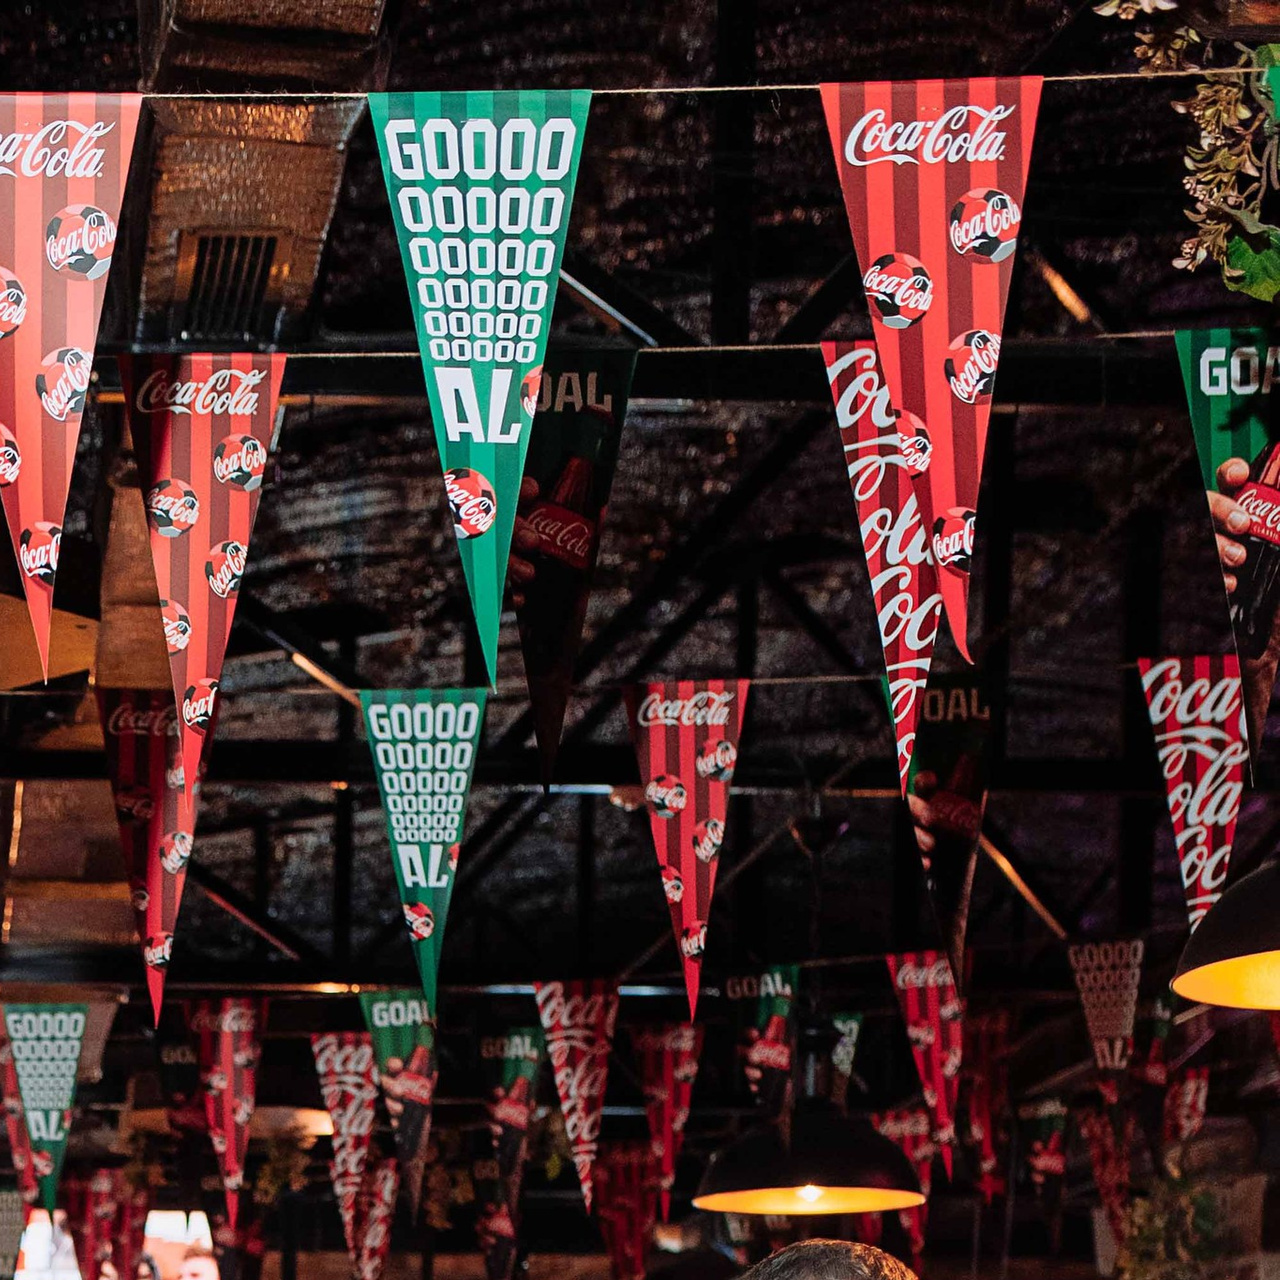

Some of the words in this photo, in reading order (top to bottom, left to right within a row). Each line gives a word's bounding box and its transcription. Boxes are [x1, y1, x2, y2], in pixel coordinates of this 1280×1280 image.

[384, 118, 576, 181] GOOOO
[845, 105, 1015, 164] Coca-Cola
[397, 186, 565, 234] OOOOO
[950, 195, 1022, 254] Coca-Cola
[46, 212, 117, 271] Coca-Cola
[409, 237, 556, 276] OOOOO
[418, 278, 548, 313] OOOOO
[863, 265, 934, 311] Coca-Cola
[424, 311, 543, 339] OOOOO
[429, 338, 537, 363] OOOOO
[136, 369, 267, 416] Coca-Cola
[434, 367, 522, 444] AL
[368, 703, 480, 740] GOOOO
[638, 691, 735, 726] Coca-Cola
[376, 741, 474, 770] OOOOO
[381, 771, 468, 794] OOOOO
[397, 845, 449, 888] AL
[6, 1011, 86, 1039] GOOOO
